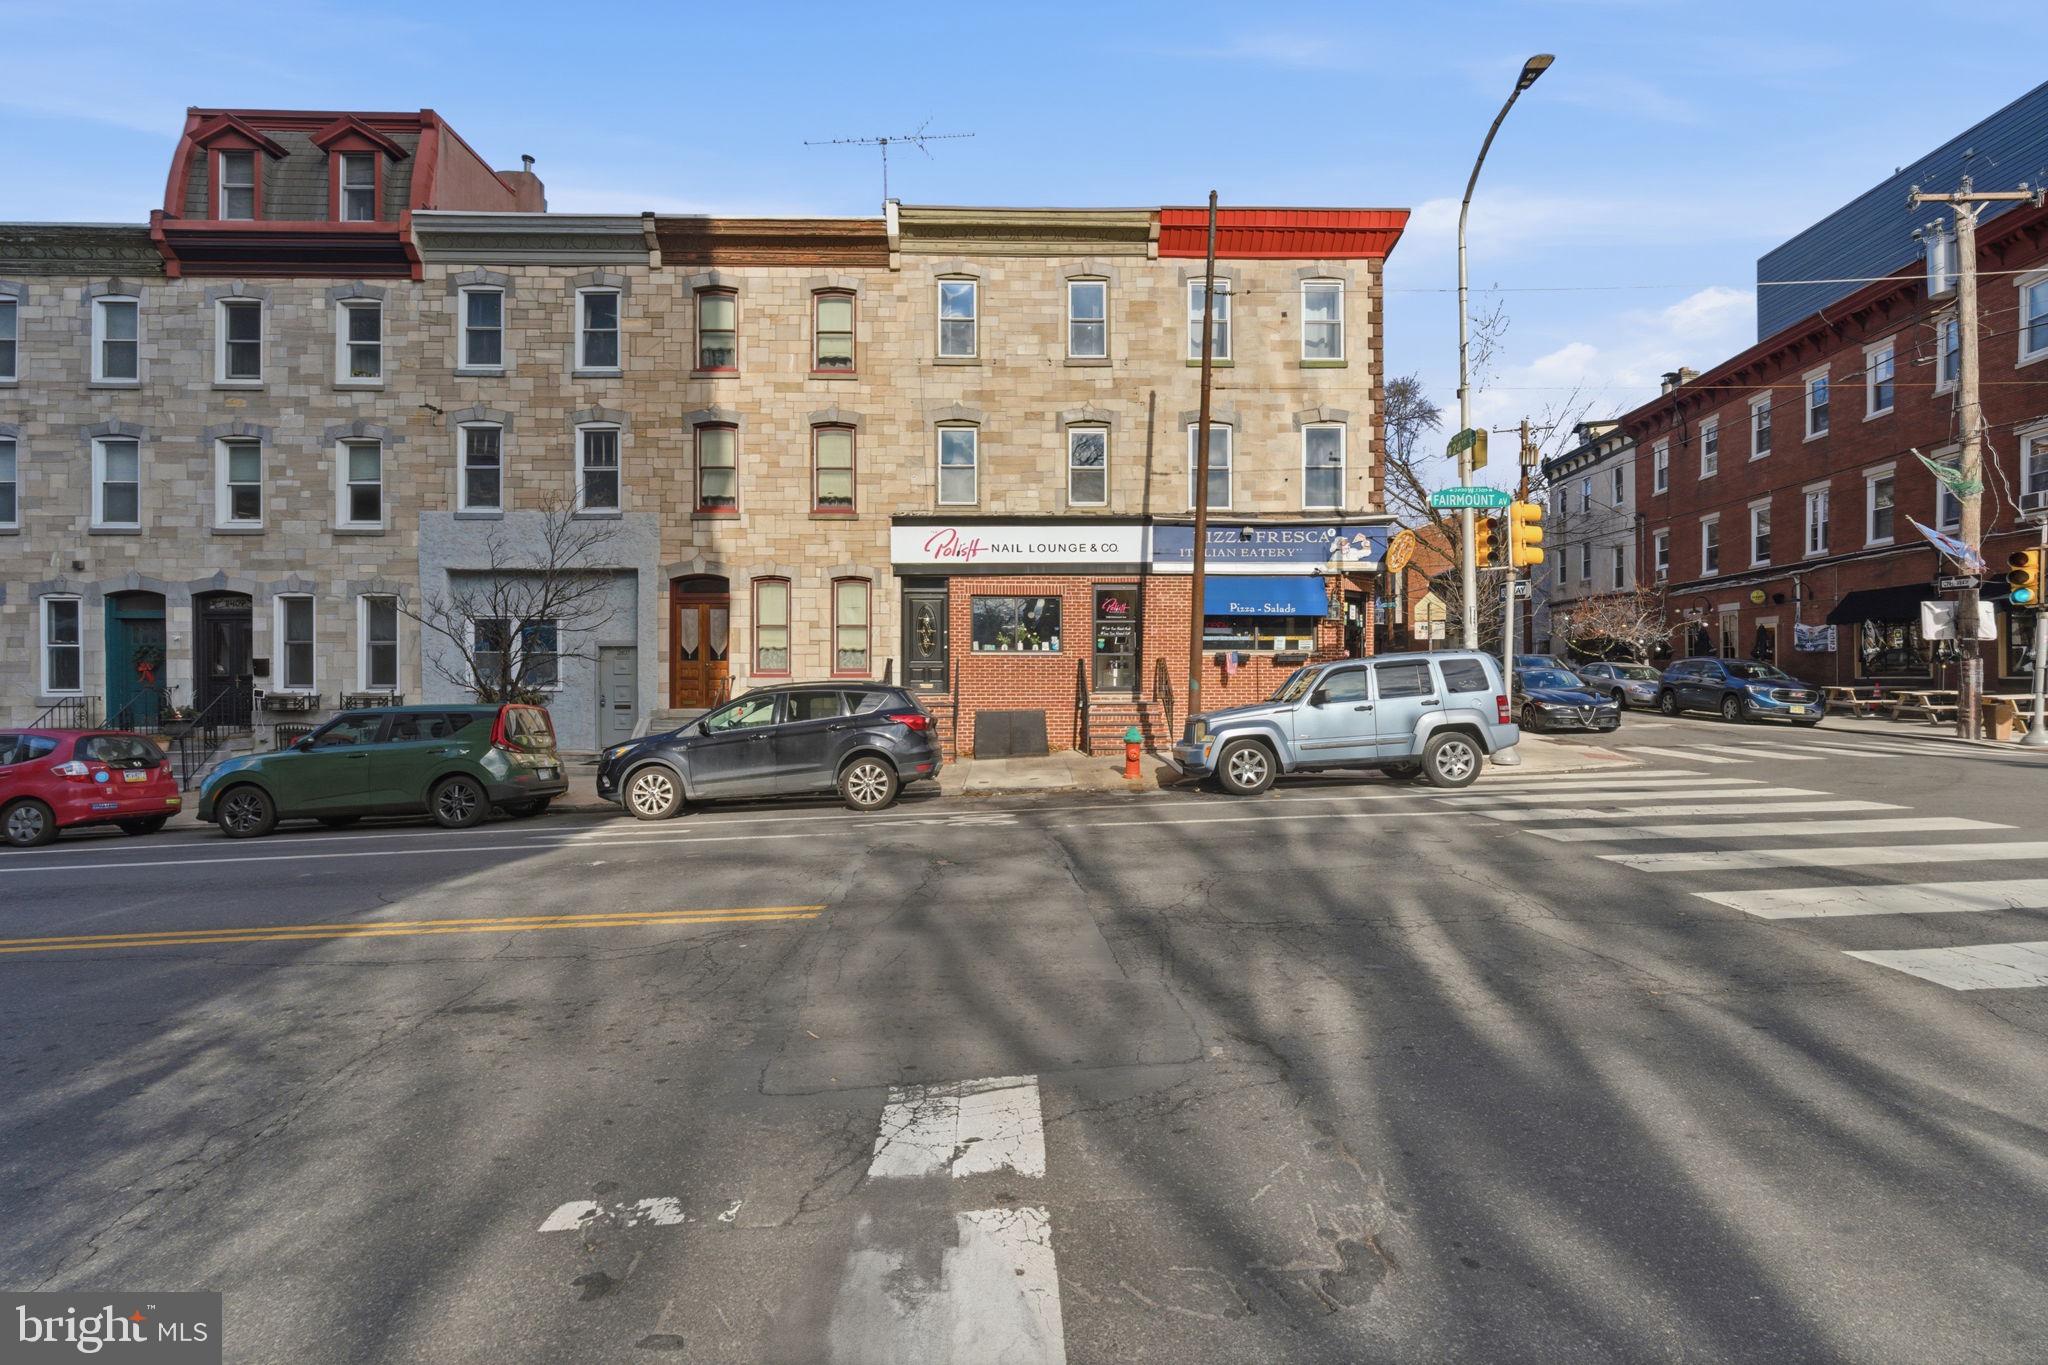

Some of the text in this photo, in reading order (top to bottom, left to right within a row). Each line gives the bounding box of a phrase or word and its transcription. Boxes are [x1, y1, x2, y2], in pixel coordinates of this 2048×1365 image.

[1433, 494, 1508, 506] FAIRMOUNT AV
[1193, 531, 1330, 544] IZZ FRESCA
[991, 543, 1023, 553] NAIL
[1028, 543, 1087, 553] LOUNGE
[1090, 543, 1098, 553] &
[1180, 548, 1237, 557] ITLIAN
[1230, 602, 1255, 613] Pizza
[1264, 602, 1296, 613] Salads
